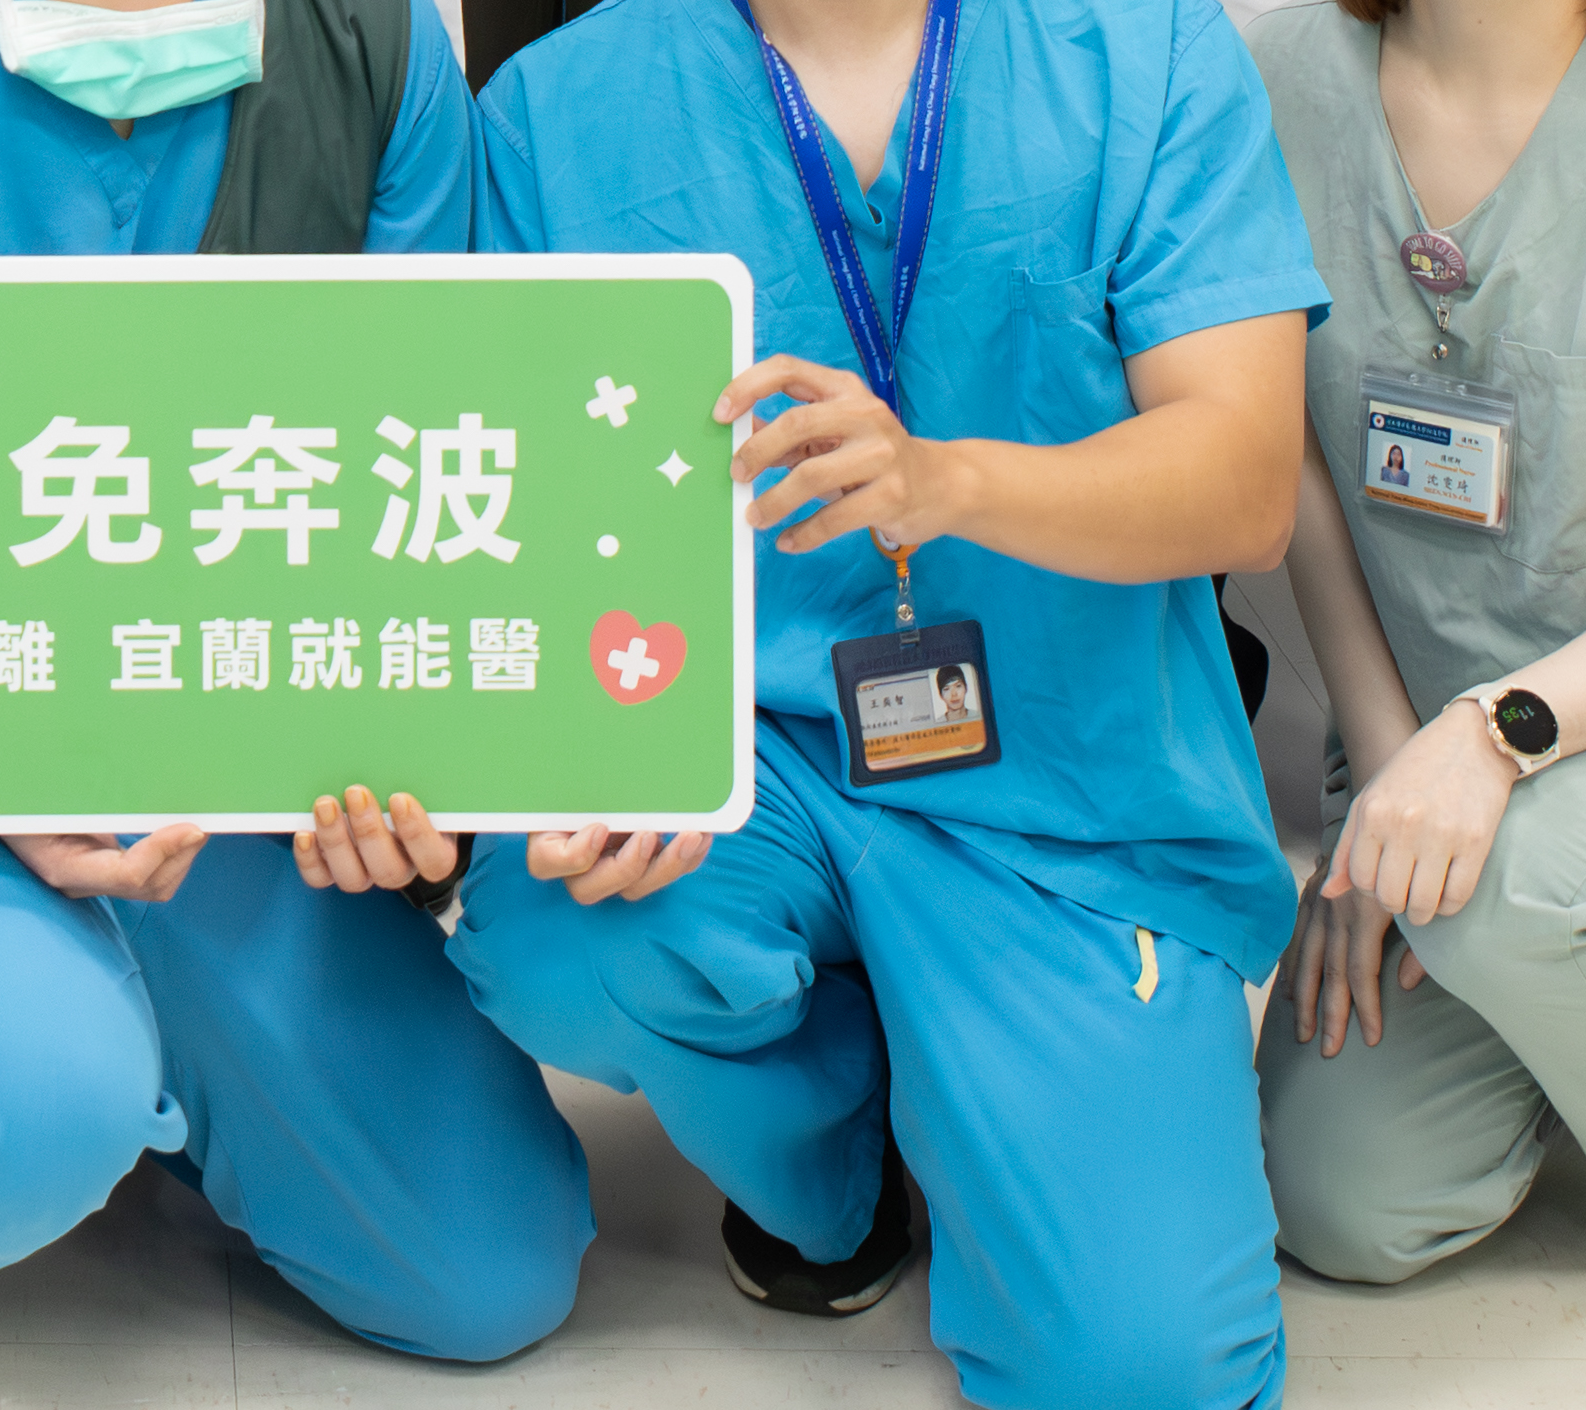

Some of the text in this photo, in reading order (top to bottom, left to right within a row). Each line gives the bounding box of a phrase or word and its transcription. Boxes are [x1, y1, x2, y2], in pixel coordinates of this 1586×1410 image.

[109, 616, 541, 692] 宜蘭就能醫
